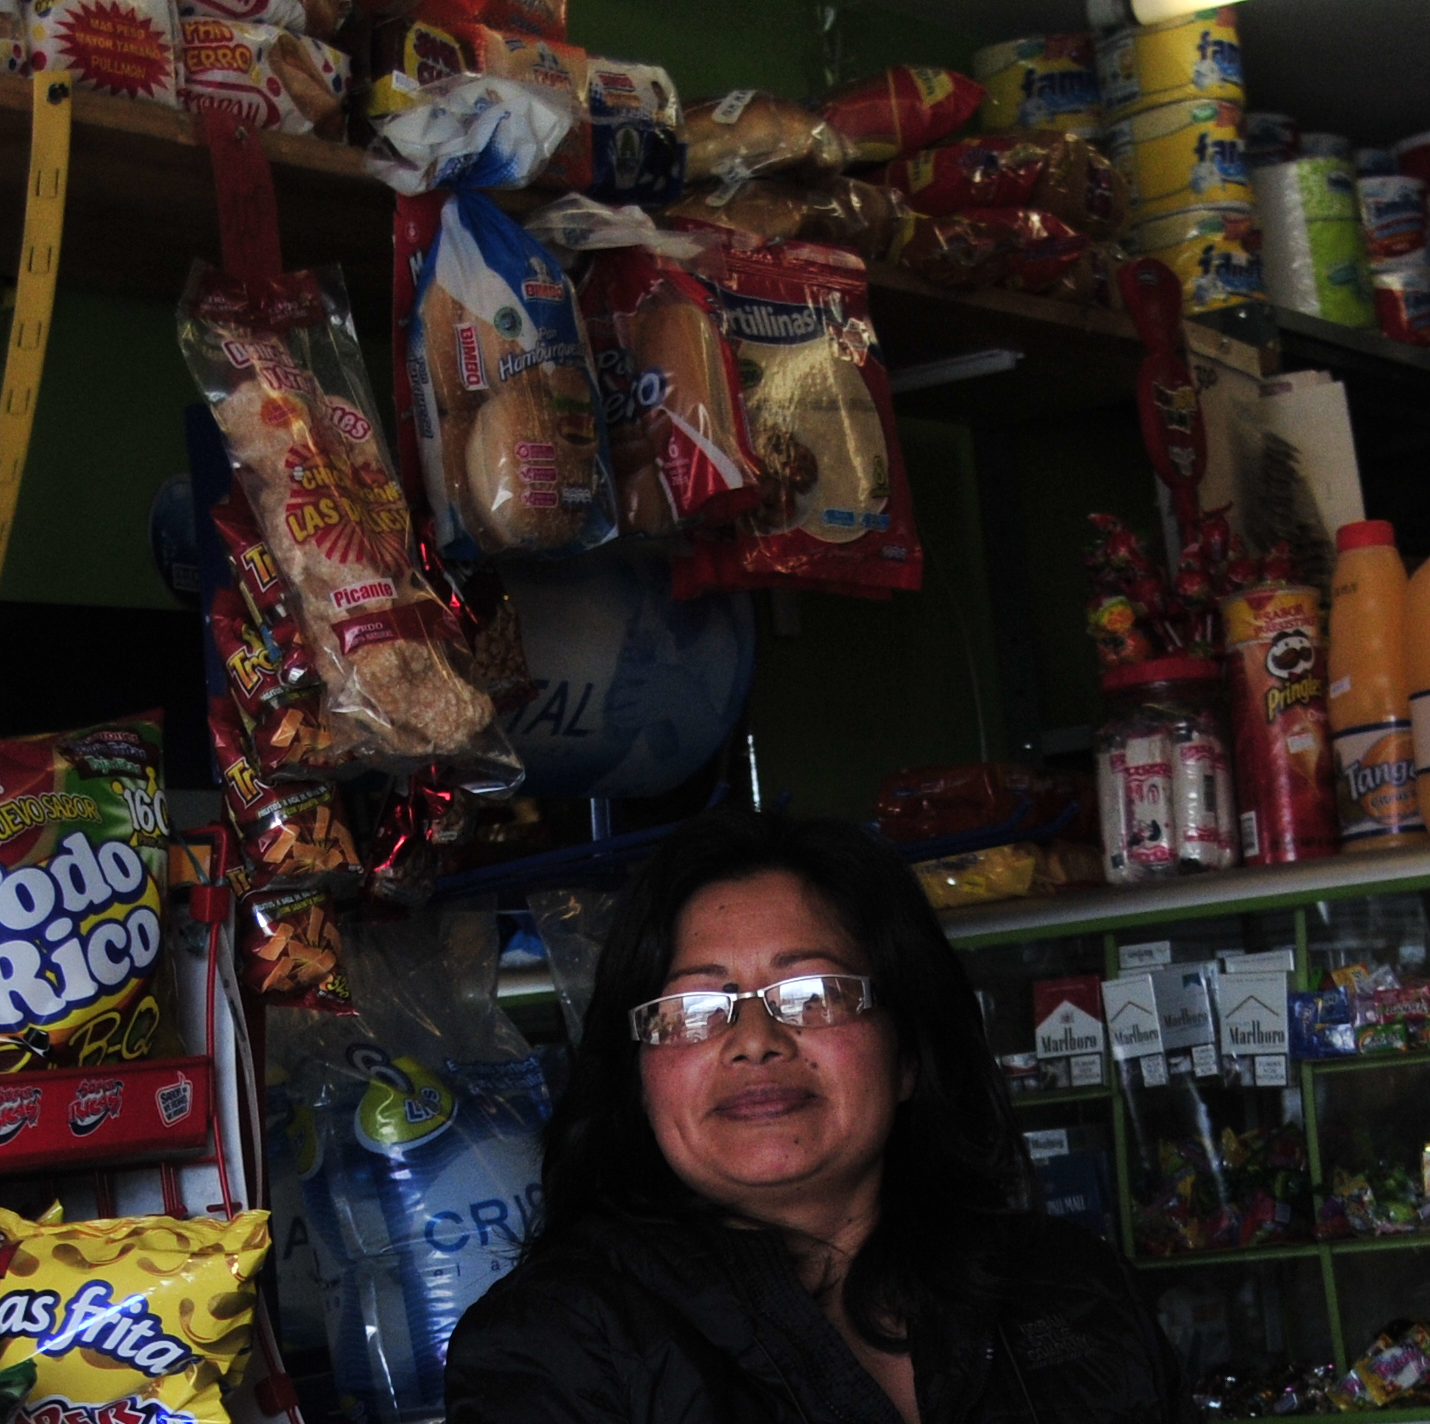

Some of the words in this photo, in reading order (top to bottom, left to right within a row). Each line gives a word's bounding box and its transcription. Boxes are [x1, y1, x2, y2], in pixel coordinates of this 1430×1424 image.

[333, 578, 394, 609] Picante
[43, 793, 101, 824] SABOR
[1163, 1008, 1208, 1028] Marlboro
[1041, 1027, 1098, 1052] Marlboro
[1114, 1023, 1160, 1046] Marlboro
[1229, 1020, 1285, 1046] Marlboro
[44, 1284, 185, 1376] frita
